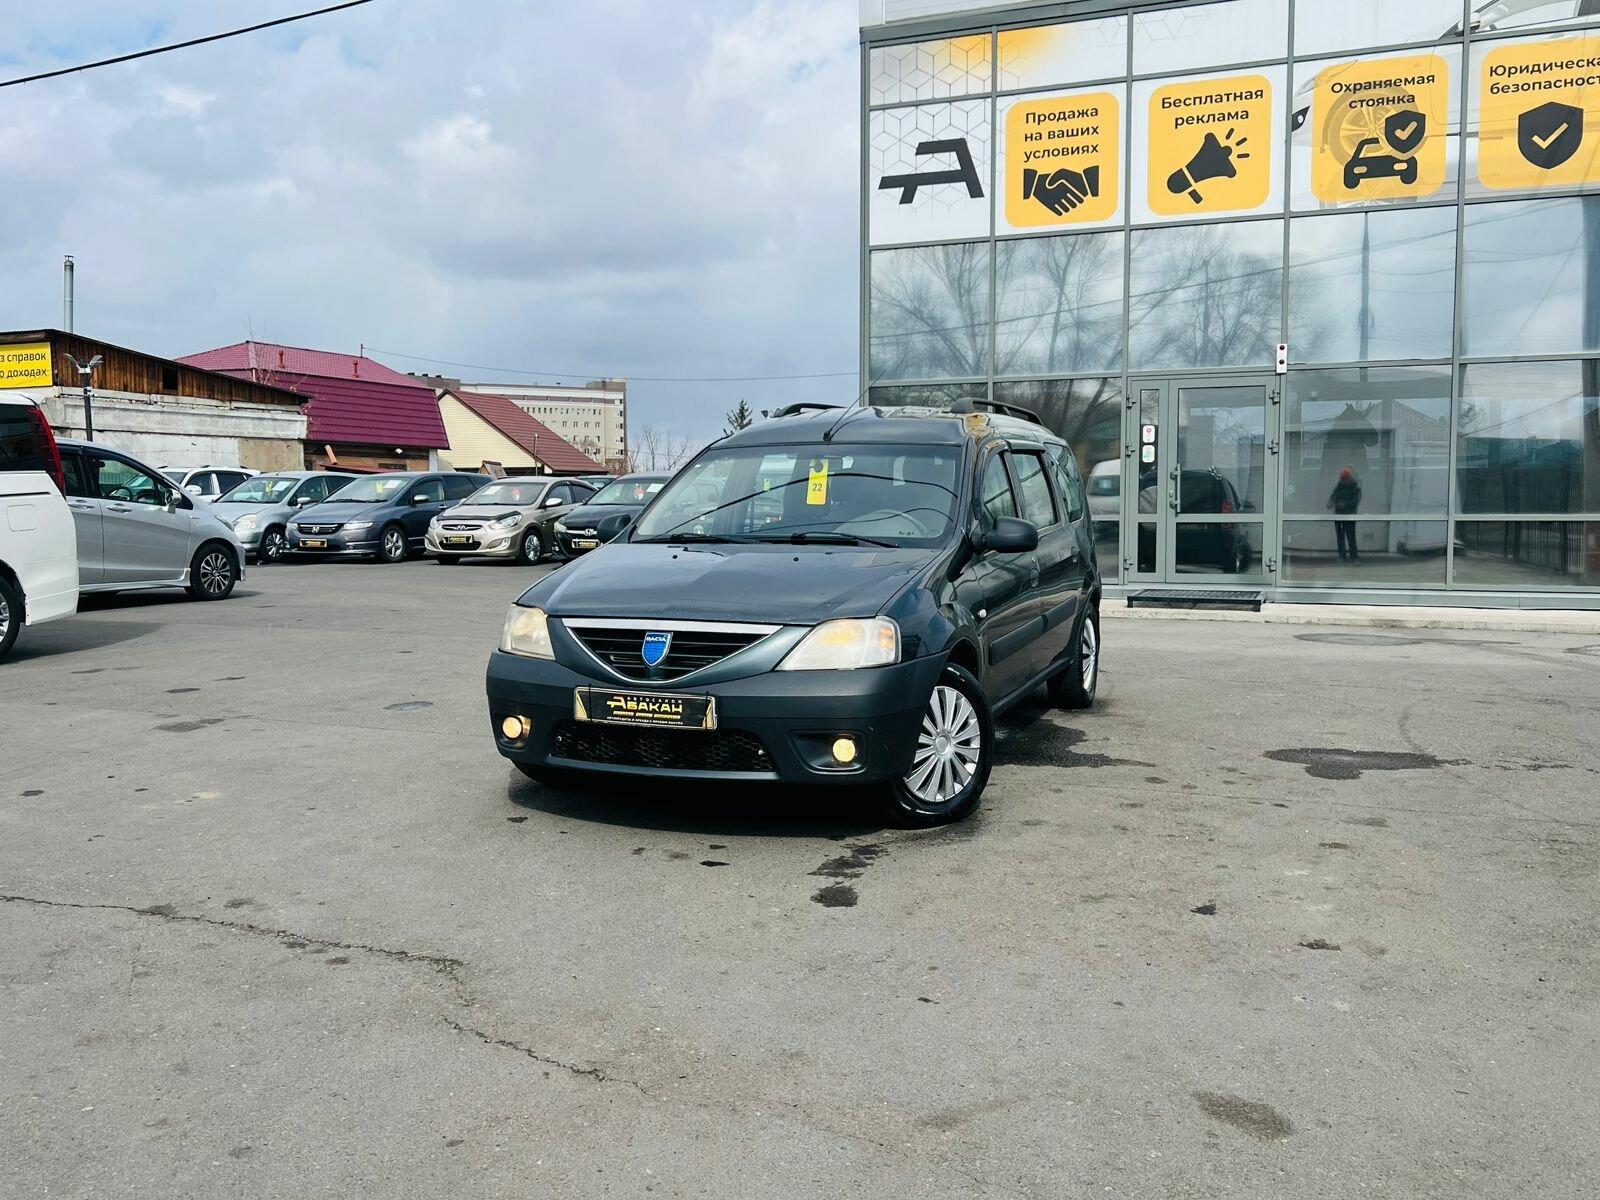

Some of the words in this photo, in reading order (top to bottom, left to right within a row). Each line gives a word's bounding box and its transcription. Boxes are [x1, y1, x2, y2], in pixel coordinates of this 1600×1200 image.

[1331, 74, 1435, 94] Охраняемая
[1161, 89, 1264, 109] Бесплатная
[1348, 94, 1416, 109] стоянка
[1025, 107, 1099, 125] Продажа
[1174, 109, 1250, 129] реклама
[1024, 131, 1043, 142] на
[1047, 125, 1100, 140] ваших
[1023, 144, 1099, 163] условиях
[6, 353, 46, 363] справок
[6, 369, 47, 379] доходах
[812, 482, 823, 492] 22
